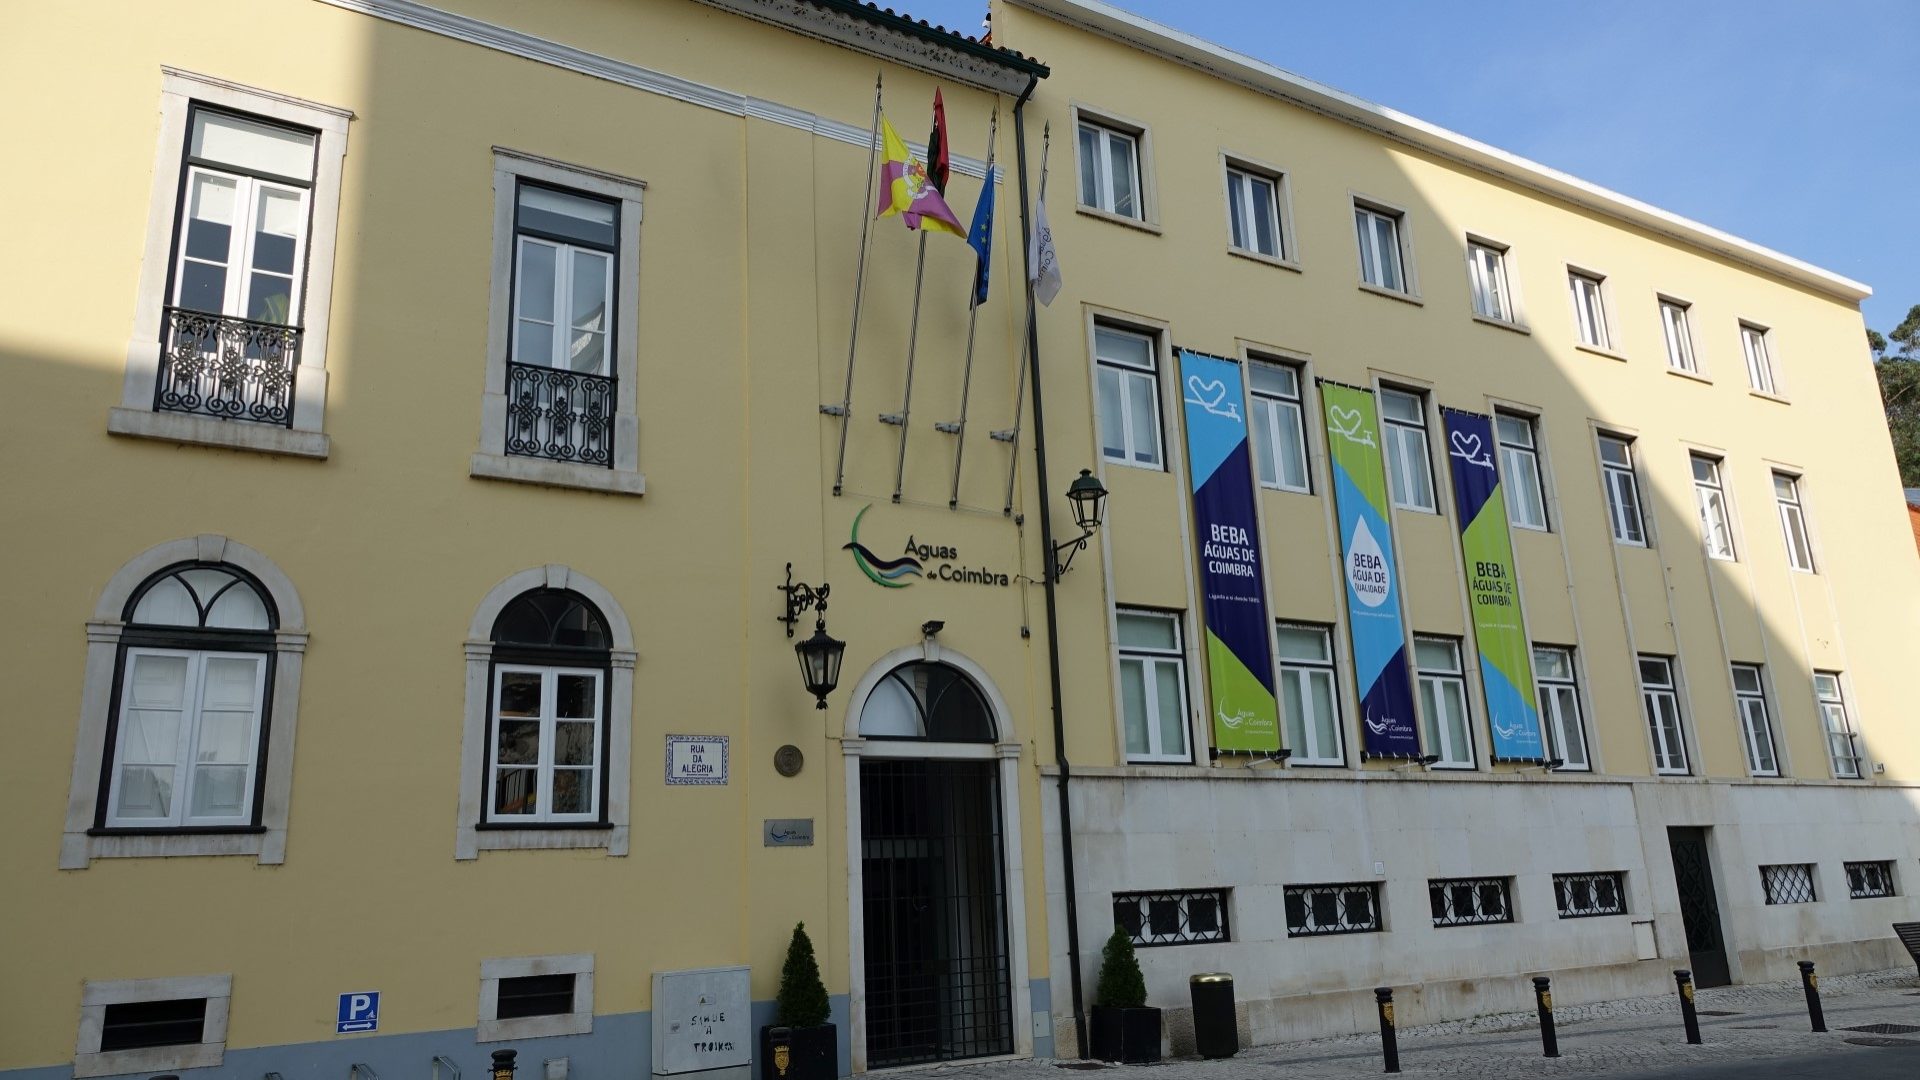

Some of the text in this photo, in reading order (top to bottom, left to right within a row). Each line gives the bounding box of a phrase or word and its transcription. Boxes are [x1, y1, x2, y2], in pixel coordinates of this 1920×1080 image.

[1210, 523, 1249, 546] BEBA
[904, 534, 958, 561] Águas
[1204, 539, 1256, 563] ÁGUAS DE
[1208, 560, 1255, 578] COIMBRA
[1353, 552, 1382, 570] BEBA
[1475, 561, 1507, 579] BEBA
[926, 564, 1009, 586] de Coimbra
[1352, 565, 1387, 584] ÁGUA DE
[1354, 582, 1387, 595] QUALIDADE
[1472, 577, 1513, 594] ÁGUAS DE
[1476, 594, 1512, 607] COIMBRA
[690, 744, 705, 754] RUA
[681, 763, 714, 773] ALEGRIA
[692, 754, 703, 764] DA
[350, 994, 371, 1020] P
